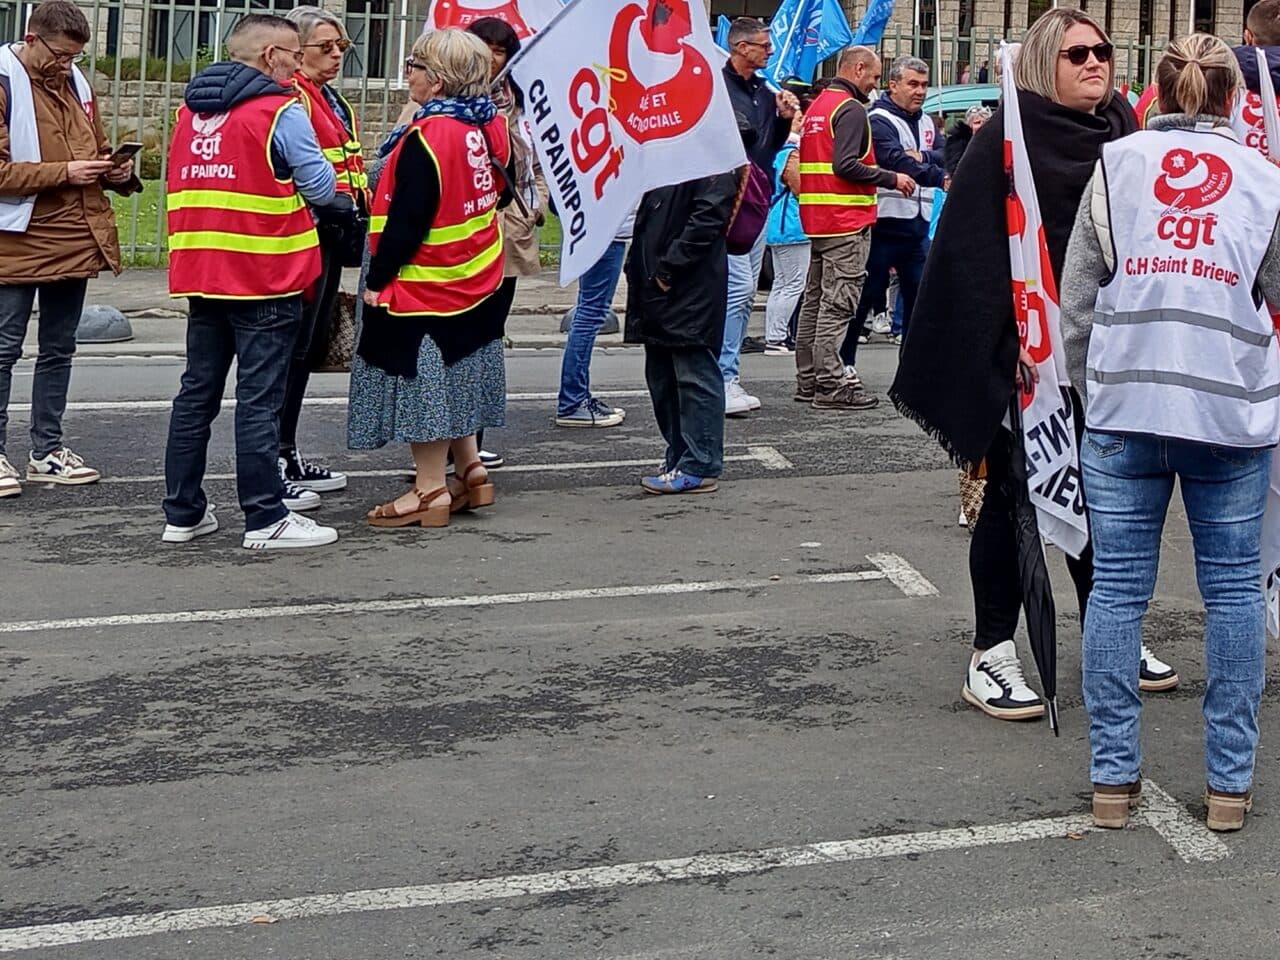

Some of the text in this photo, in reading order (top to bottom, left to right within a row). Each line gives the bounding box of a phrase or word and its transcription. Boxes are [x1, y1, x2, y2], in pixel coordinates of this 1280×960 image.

[652, 92, 667, 108] ET
[190, 132, 222, 161] cgt
[568, 66, 625, 201] cgt
[528, 78, 587, 256] CH PAIMPOL
[1157, 212, 1218, 250] cgt
[1125, 255, 1240, 287] C.H Saint Brieuc
